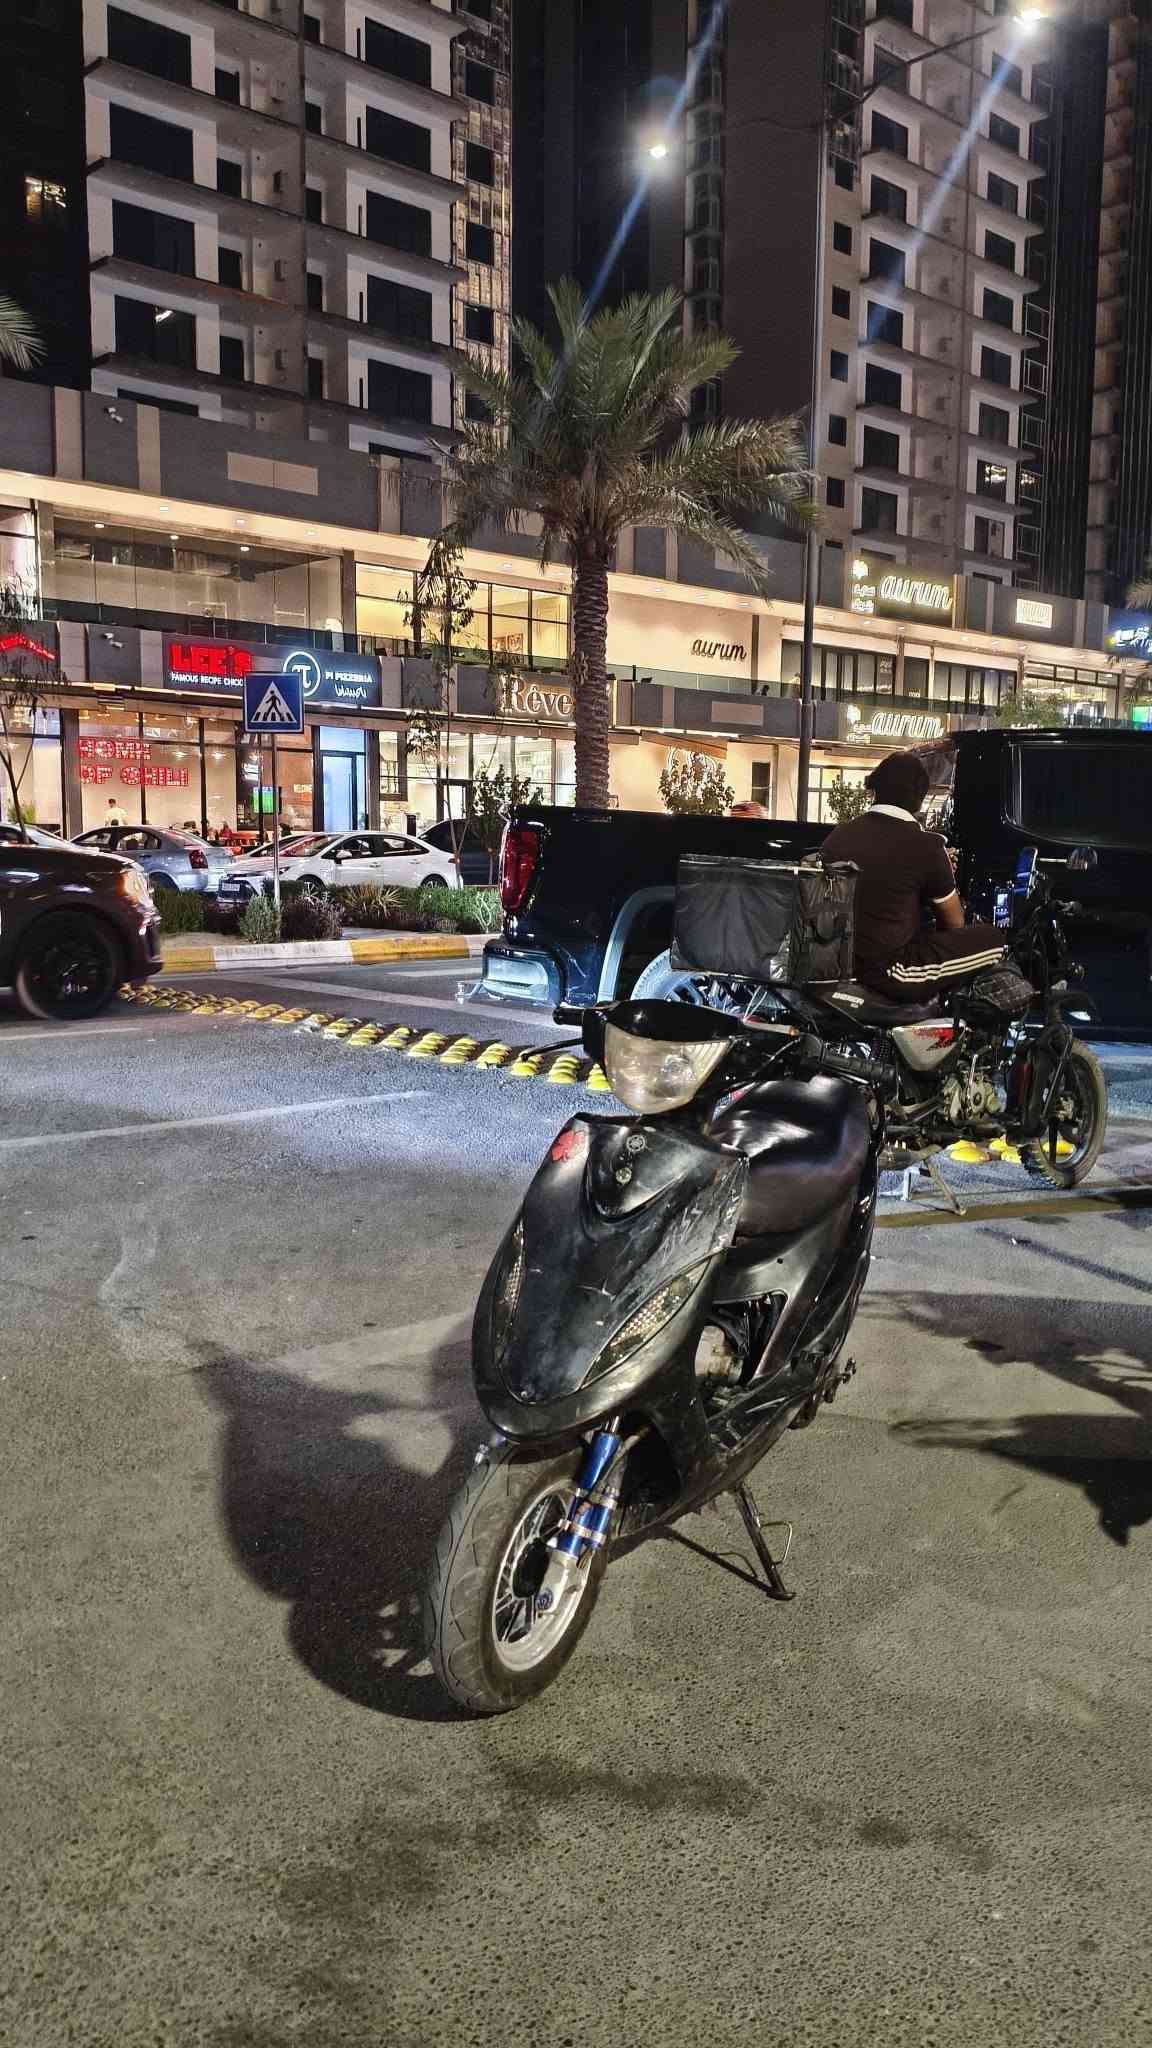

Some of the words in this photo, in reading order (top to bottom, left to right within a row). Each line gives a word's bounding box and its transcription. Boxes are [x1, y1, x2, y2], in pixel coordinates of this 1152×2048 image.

[171, 643, 252, 676] LEE'S
[692, 639, 747, 660] aurum
[171, 672, 199, 684] FAMOUS
[200, 675, 222, 686] RECIPE
[872, 711, 945, 739] aurum
[80, 766, 112, 784] OF
[121, 767, 189, 786] CHILI
